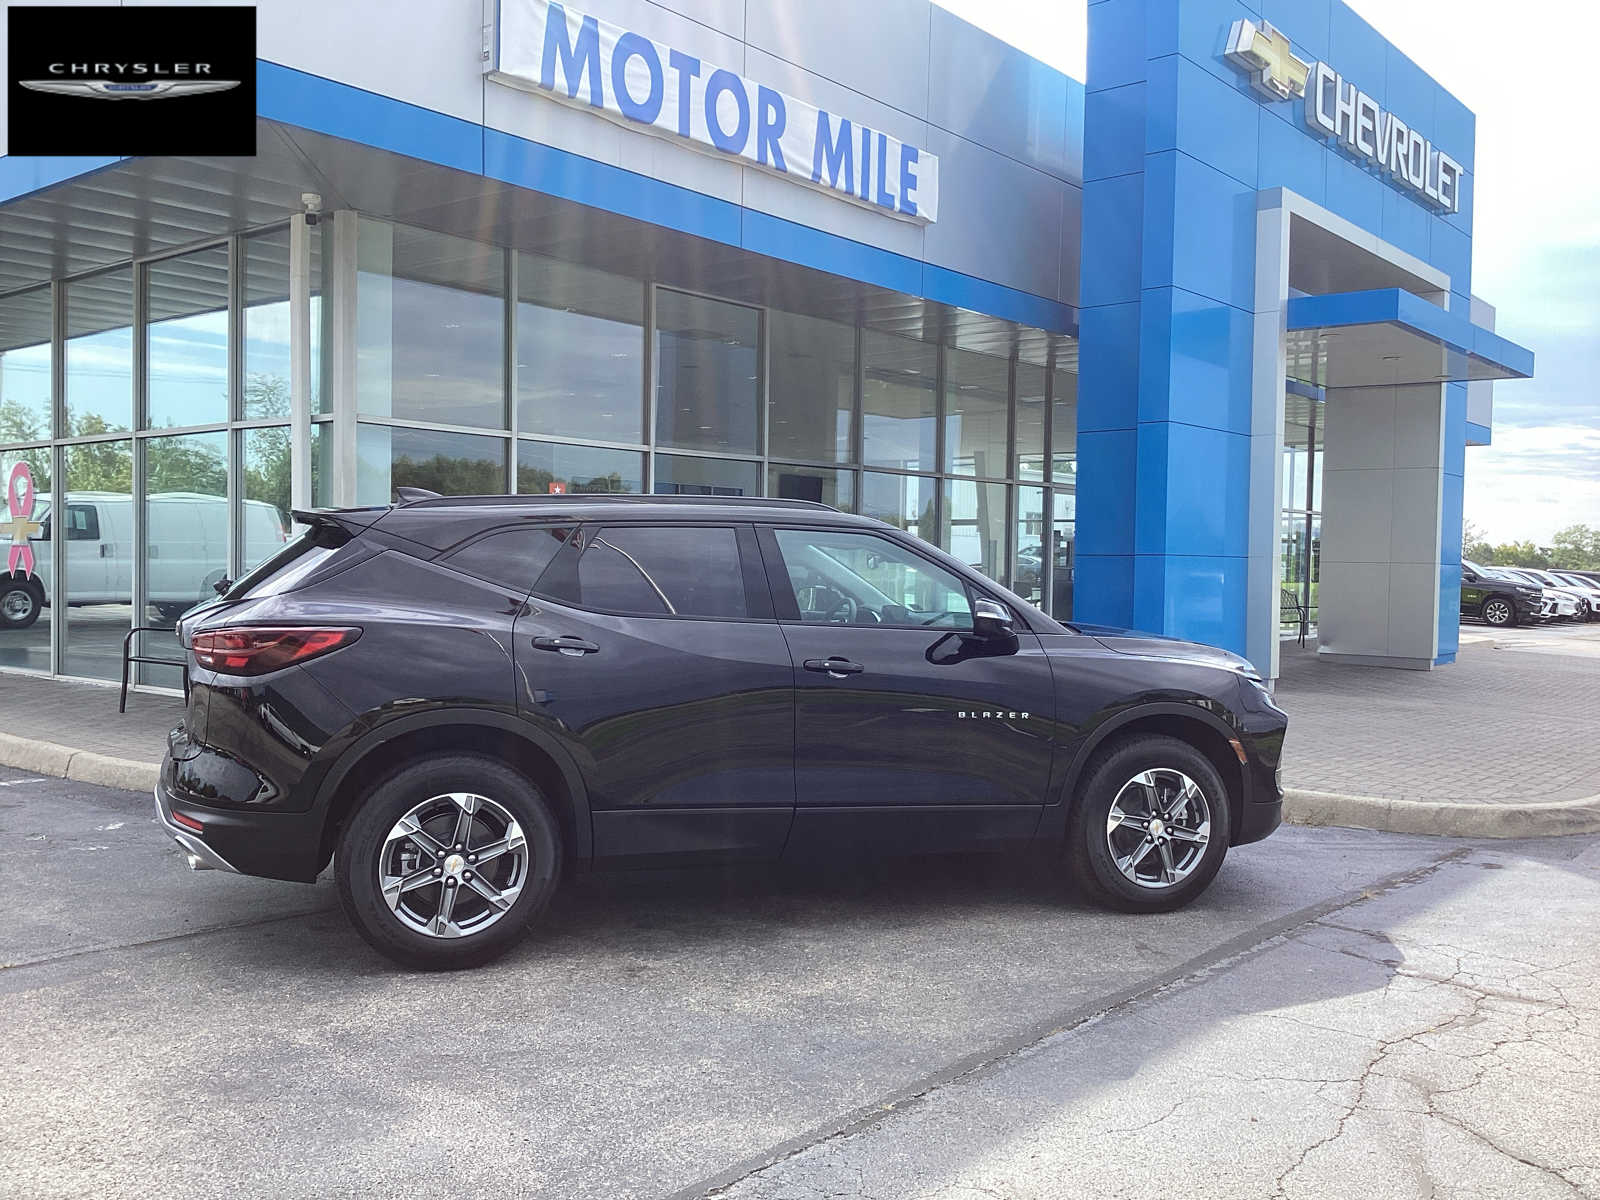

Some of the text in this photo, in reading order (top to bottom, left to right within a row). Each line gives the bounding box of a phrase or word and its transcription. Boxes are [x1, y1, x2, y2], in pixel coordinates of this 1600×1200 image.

[540, 3, 919, 216] MOTOR MILE
[1309, 61, 1464, 213] CHEVROLET
[957, 711, 1030, 719] BLAZER
